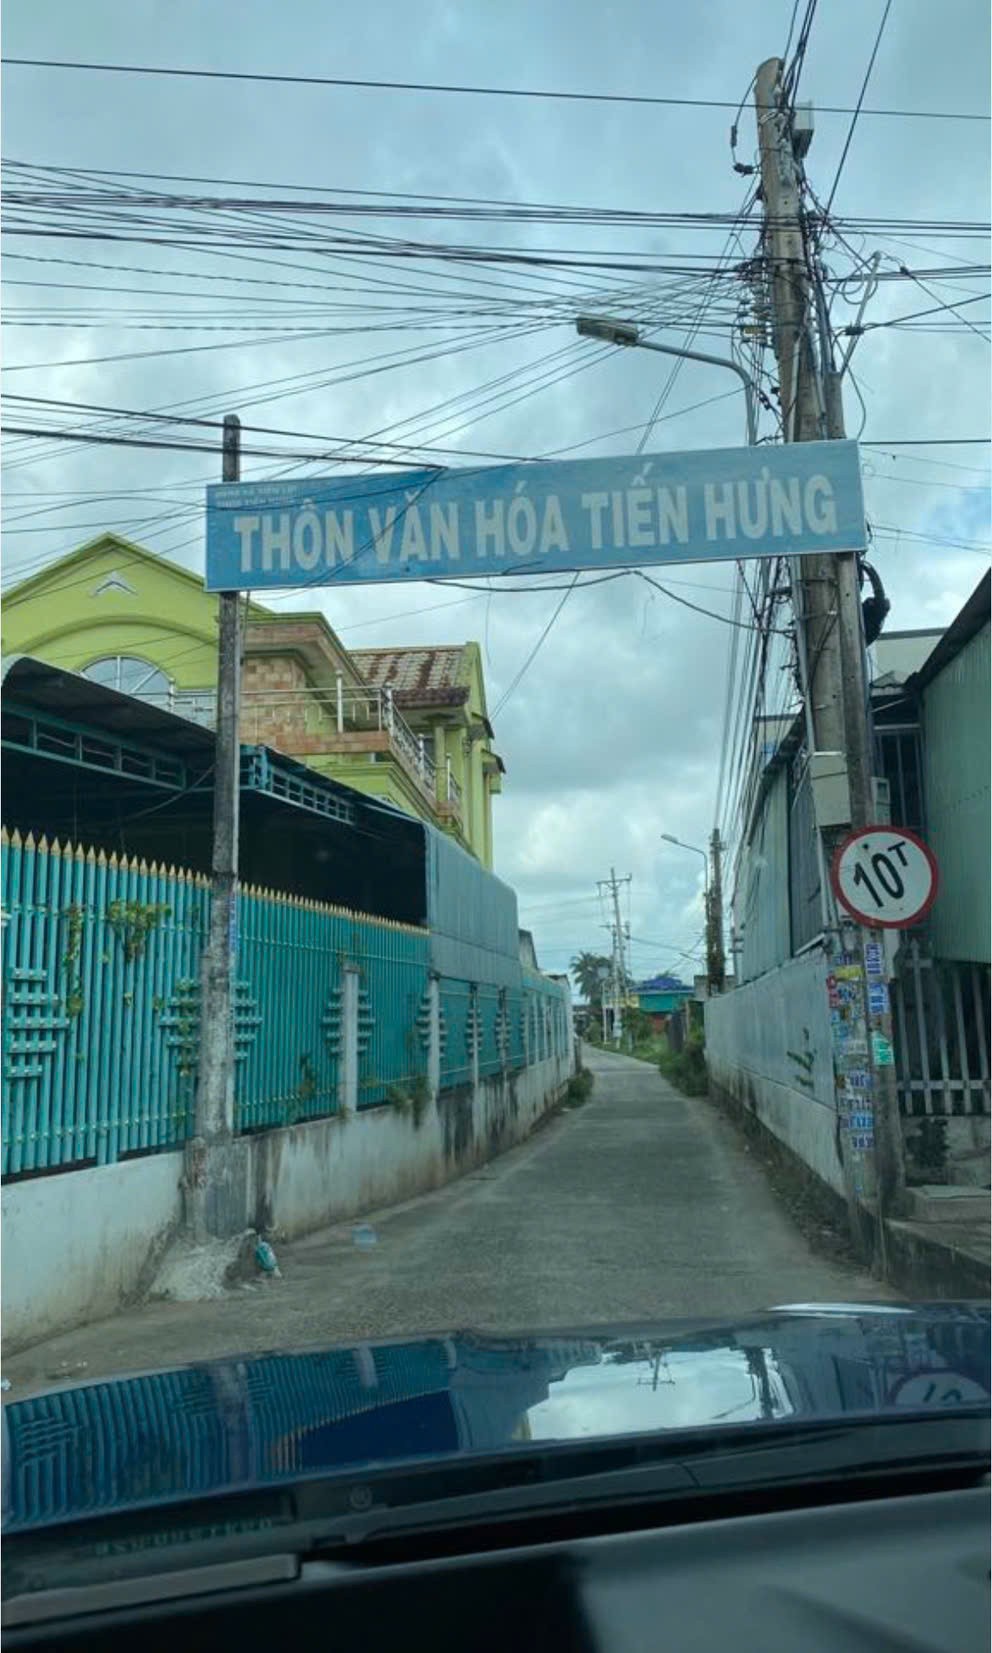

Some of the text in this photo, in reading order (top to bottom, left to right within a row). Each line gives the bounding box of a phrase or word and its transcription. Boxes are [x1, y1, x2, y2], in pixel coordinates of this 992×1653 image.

[234, 461, 838, 574] THÔN VĂN HÓA TIẾN HƯNG
